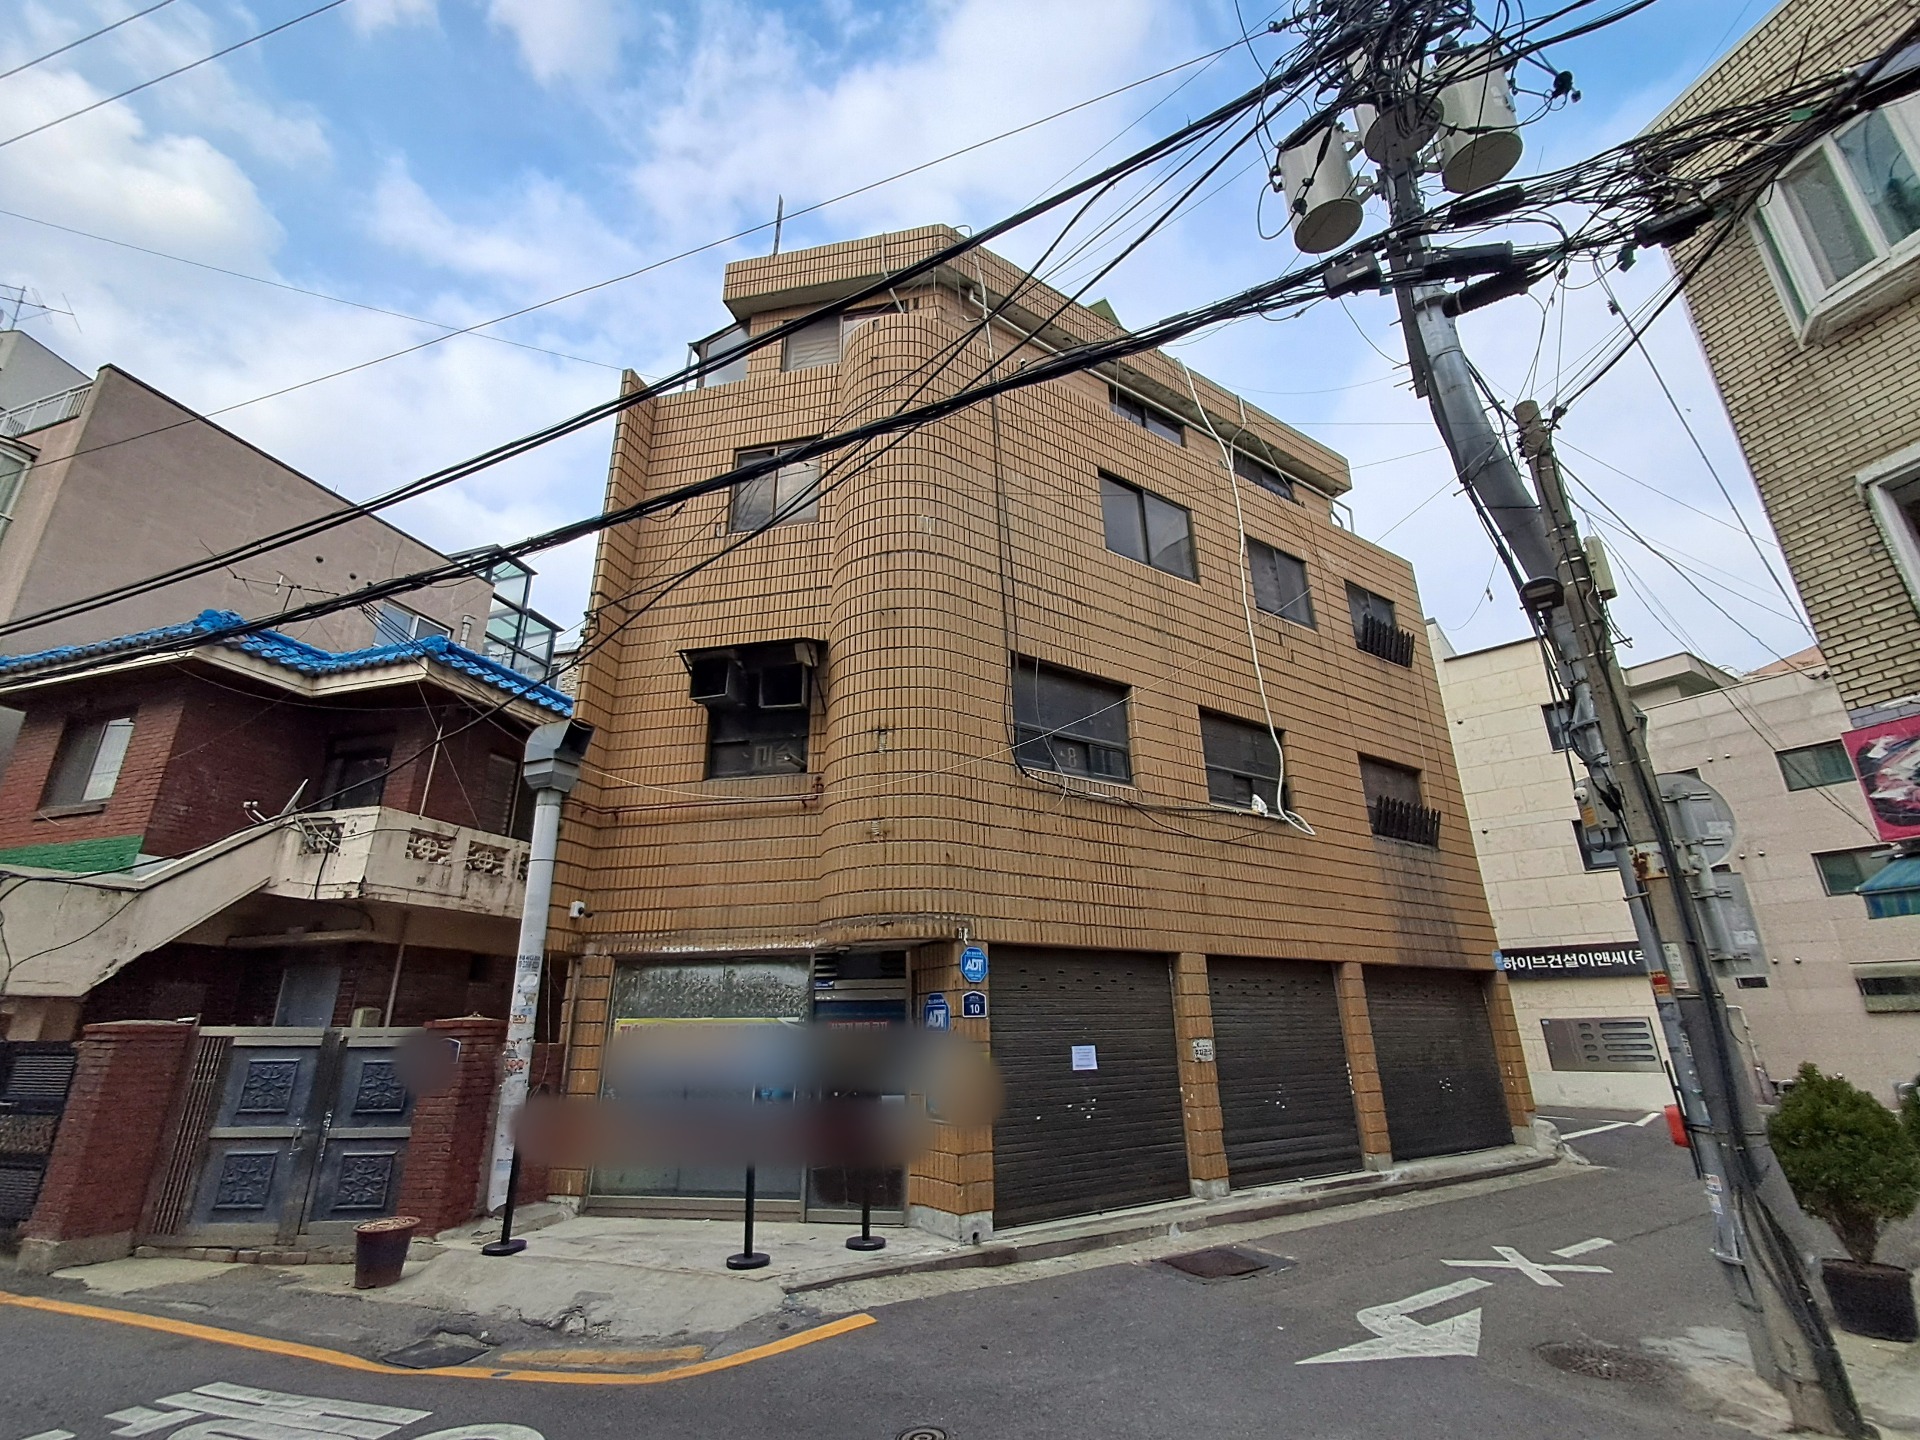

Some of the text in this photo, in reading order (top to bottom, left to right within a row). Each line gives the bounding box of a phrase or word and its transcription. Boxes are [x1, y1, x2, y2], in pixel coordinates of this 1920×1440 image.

[965, 958, 984, 972] ADT
[970, 1003, 980, 1014] 10
[927, 1009, 947, 1028] ADT
